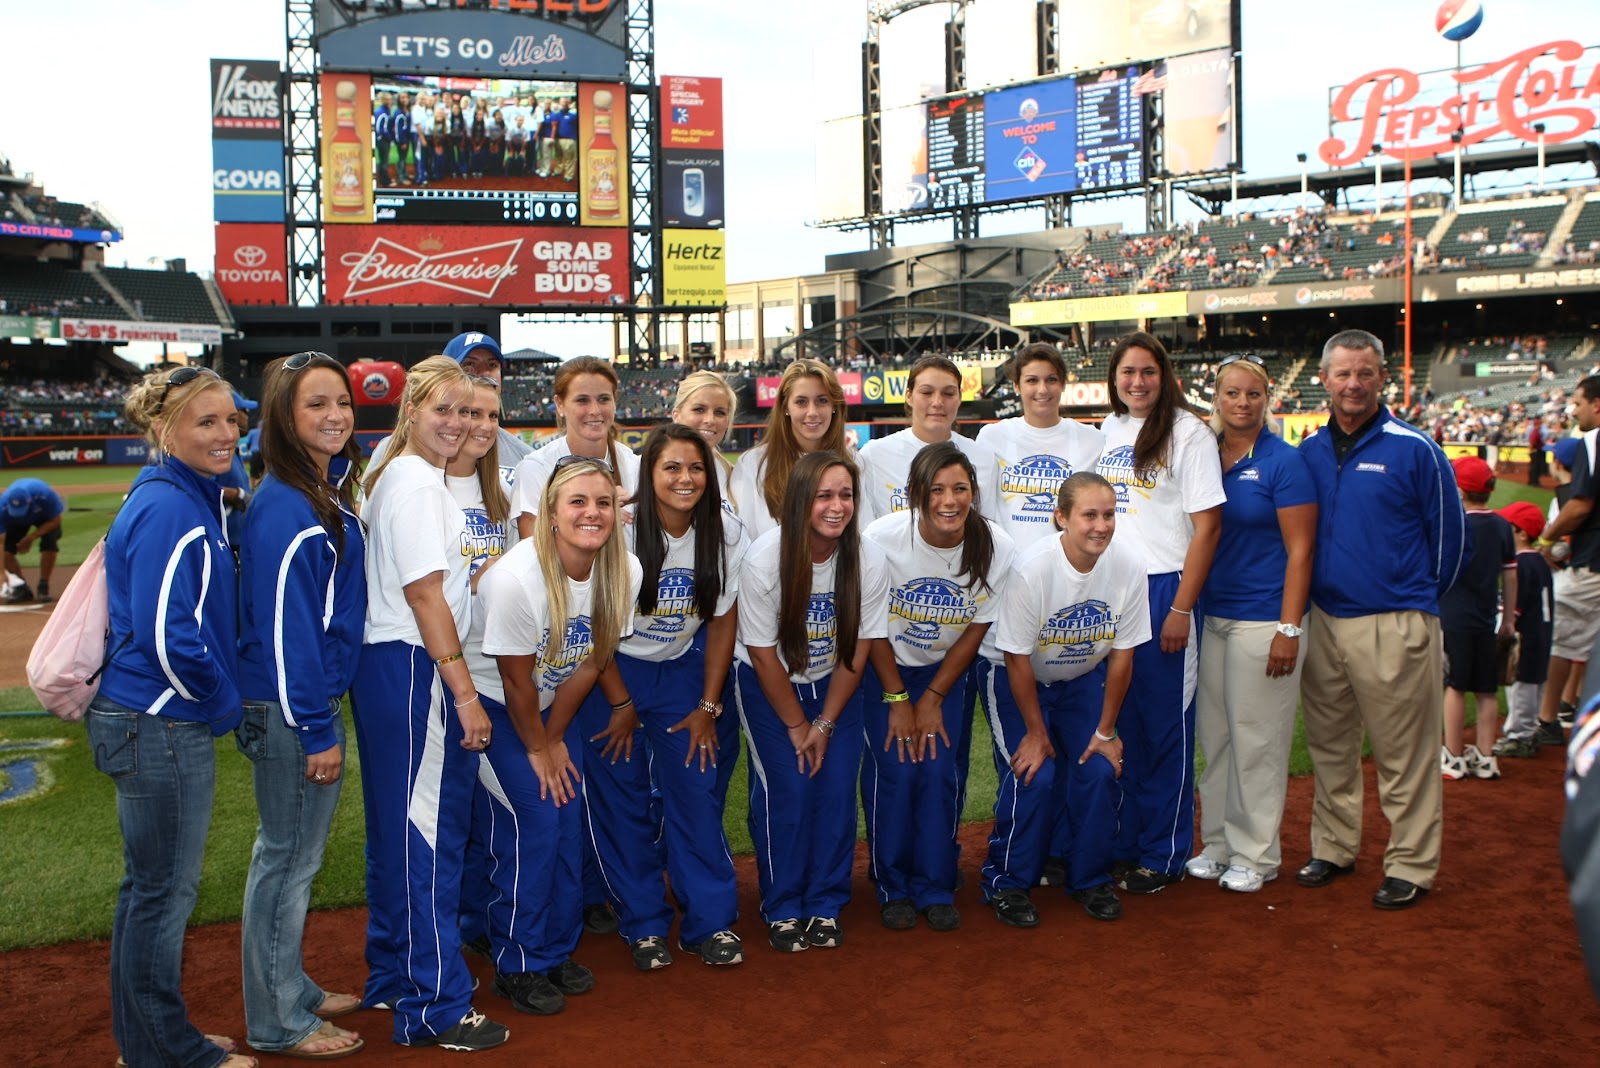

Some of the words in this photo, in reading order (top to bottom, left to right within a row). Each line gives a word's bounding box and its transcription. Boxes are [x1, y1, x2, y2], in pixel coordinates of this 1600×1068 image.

[381, 36, 450, 58] LET'S
[457, 38, 494, 59] GO
[499, 34, 567, 67] Mets
[234, 80, 278, 99] FOX
[222, 99, 280, 117] NEWS
[1003, 120, 1056, 138] WELCOME
[1022, 134, 1038, 145] TO
[213, 169, 281, 190] GOYA
[534, 202, 546, 217] 0
[550, 203, 561, 218] 0
[566, 203, 577, 218] 0
[0, 223, 17, 233] TO
[19, 225, 41, 235] CITI
[43, 227, 73, 238] FIELD
[533, 241, 612, 260] GRAB
[666, 243, 722, 260] Hertz
[340, 252, 519, 282] Budweiser
[547, 261, 599, 273] SOME
[219, 269, 283, 282] TOYOTA
[535, 274, 612, 293] BUDS
[667, 287, 724, 296] hertzequip.com
[1312, 287, 1342, 301] pepsi
[1219, 294, 1248, 307] pepsi
[64, 322, 118, 339] BOB'S
[121, 330, 178, 342] FURNITURE
[49, 447, 104, 461] verizon
[1100, 456, 1135, 467] SOFTBA
[1013, 464, 1072, 479] SOFTBALL
[1358, 463, 1385, 471] HOFSTRA
[1001, 471, 1062, 496] CHAMPIO
[1011, 514, 1049, 523] UNDEFEATED
[469, 523, 505, 536] TBALL
[896, 588, 965, 607] SOFTBALL
[650, 623, 685, 631] HOFSTRA
[1048, 611, 1113, 629] SOFTBALL
[905, 629, 940, 638] HOFSTRA
[894, 635, 932, 650] UNDEFEATED
